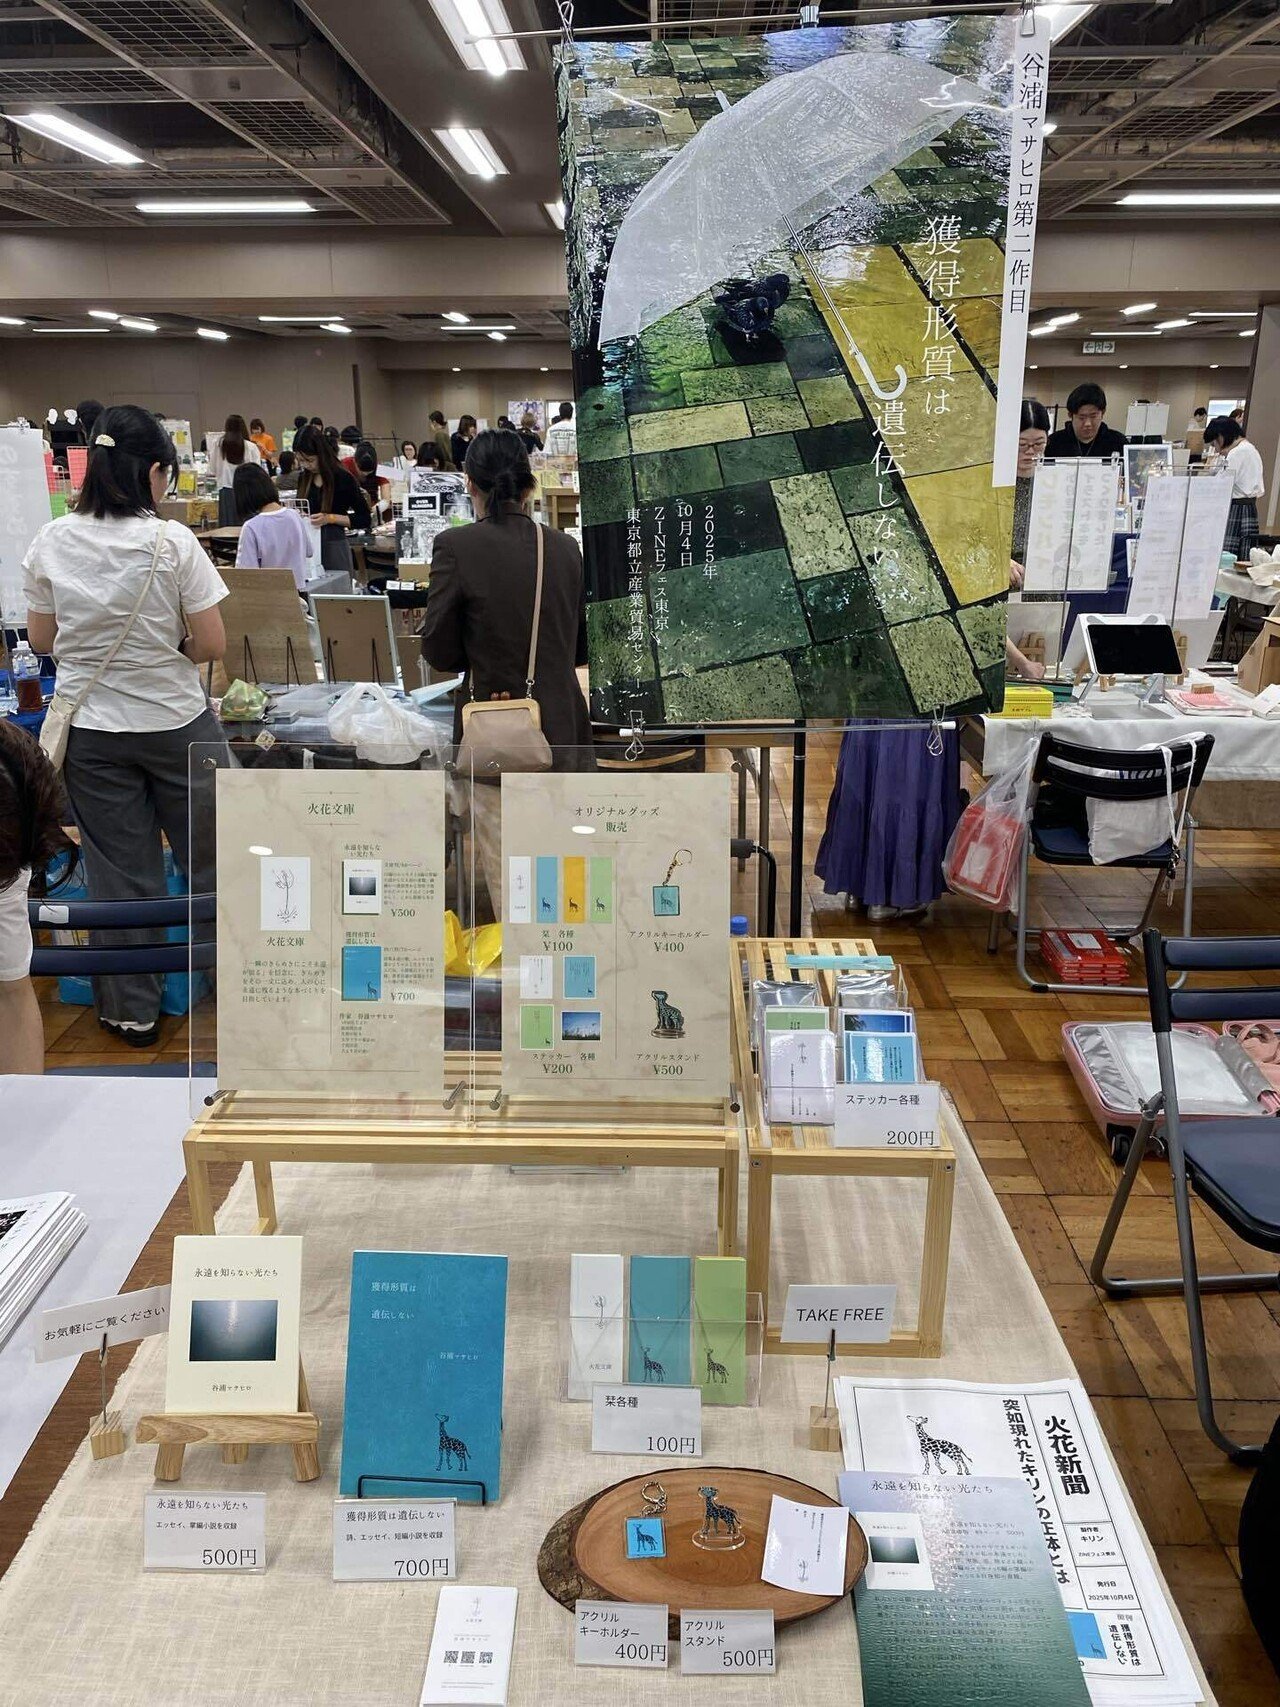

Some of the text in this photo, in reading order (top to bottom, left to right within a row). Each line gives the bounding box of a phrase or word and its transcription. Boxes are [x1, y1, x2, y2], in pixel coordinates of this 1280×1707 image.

[1009, 52, 1044, 314] 谷浦マサヒロ第二作目
[922, 215, 962, 416] 獲得形質は
[871, 401, 906, 567] 遺伝しない
[677, 504, 693, 567] 10月4日
[703, 505, 718, 580] 2025年
[654, 506, 670, 631] ZINEフェス東京
[626, 508, 644, 690] 東京都立産業貿易センター
[307, 802, 355, 816] 火花文庫
[575, 806, 660, 817] オリジナルグッズ
[605, 821, 627, 833] 販売
[558, 930, 574, 939] 各種
[629, 930, 710, 939] アクリルキーホルダー
[266, 937, 304, 946] 火花文庫
[532, 1052, 596, 1062] ステッカー 各種
[636, 1052, 700, 1062] アクリルスタンド
[845, 1094, 920, 1105] ステッカー各種
[887, 1130, 935, 1146] 200円
[194, 1267, 278, 1278] 永遠を知らない光たち
[371, 1282, 417, 1293] 獲得形質は
[371, 1309, 415, 1320] 遺伝しない
[796, 1307, 885, 1322] TAKE FREE
[44, 1306, 165, 1342] お気軽にご覧ください
[212, 1384, 252, 1393] 谷浦マサヒロ
[605, 1395, 639, 1408] 栞各種
[647, 1436, 696, 1454] 100円
[1045, 1415, 1090, 1496] 火花新聞
[871, 1480, 993, 1494] 永遠を知らない光たち
[156, 1498, 249, 1511] 永遠を知らない光たち
[346, 1510, 445, 1522] 獲得形質は遺伝しない
[156, 1521, 237, 1531] エッセイ、掌編小説を収録
[346, 1531, 443, 1541] 詩、エッセイ、短編小説を収録
[1080, 1535, 1104, 1543] キリン
[202, 1548, 257, 1566] 500円
[394, 1558, 449, 1577] 700円
[1097, 1580, 1117, 1588] 発行日
[580, 1611, 619, 1623] アクリル
[579, 1626, 640, 1638] キーホルダー
[685, 1620, 725, 1631] アクリル
[685, 1635, 725, 1647] スタンド
[1108, 1624, 1128, 1666] 遺伝しない
[1120, 1623, 1142, 1667] 獲得形質は
[615, 1643, 667, 1662] 400円
[723, 1648, 774, 1667] 500円
